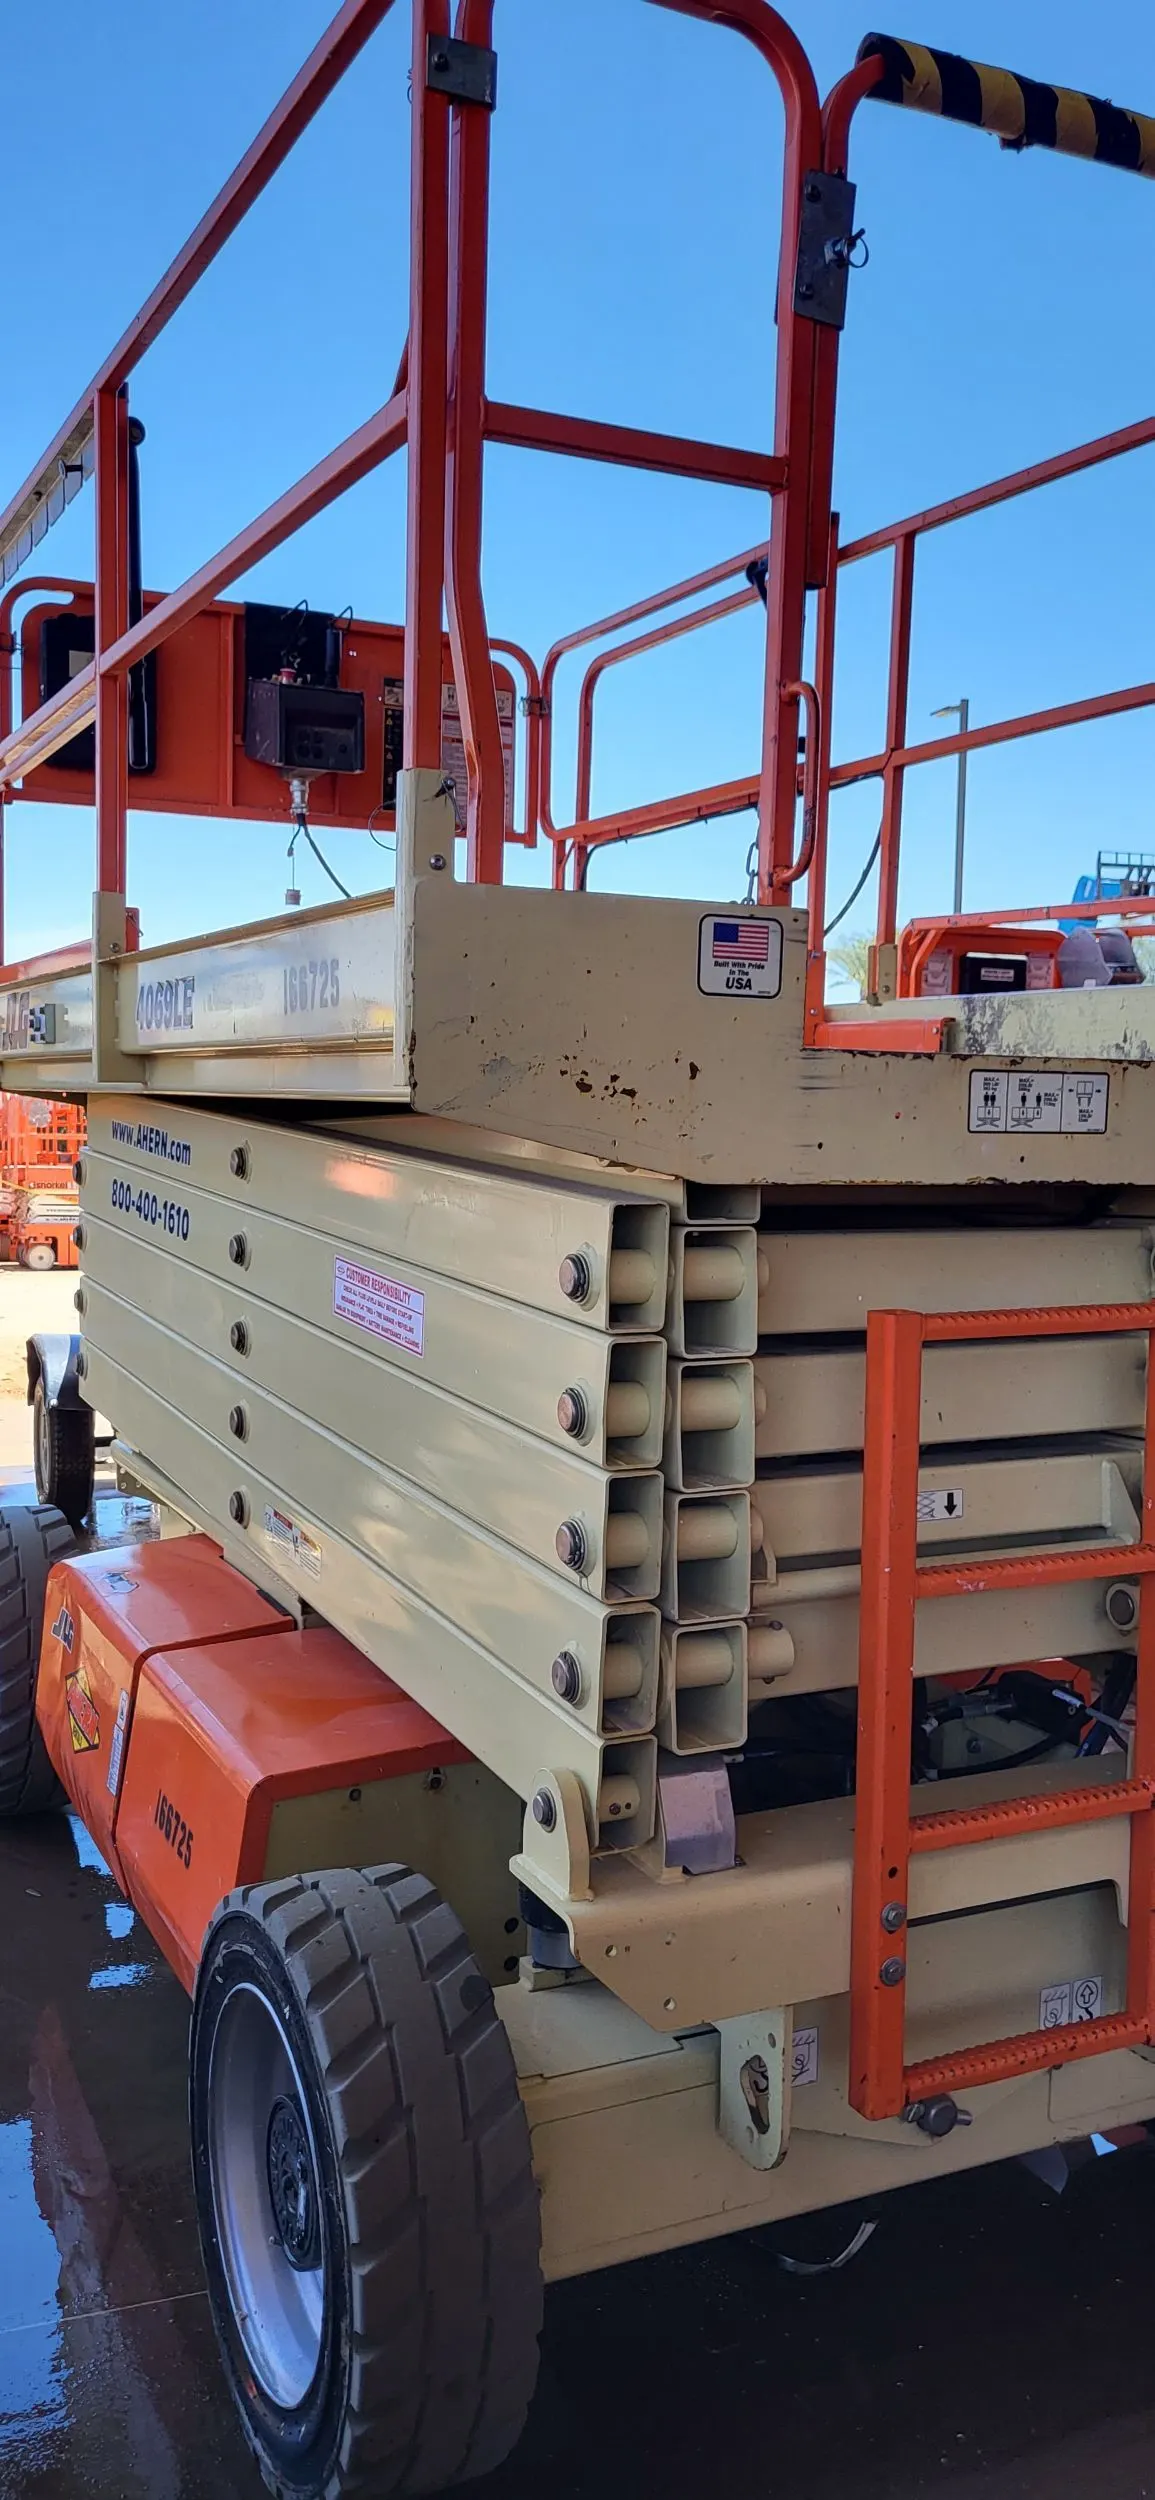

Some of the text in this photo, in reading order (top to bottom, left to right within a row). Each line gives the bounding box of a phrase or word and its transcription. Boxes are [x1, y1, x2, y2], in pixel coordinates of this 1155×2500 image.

[283, 957, 340, 1016] 166725
[725, 976, 752, 991] USA
[747, 962, 765, 970] Pride
[136, 975, 195, 1031] 4069LE
[111, 1120, 191, 1166] www.AHERN.com
[111, 1178, 190, 1241] 800-400-1610
[345, 1266, 371, 1288] CUSTOMER
[371, 1277, 411, 1306] RESPONSIBILITY
[154, 1788, 194, 1870] 166725
